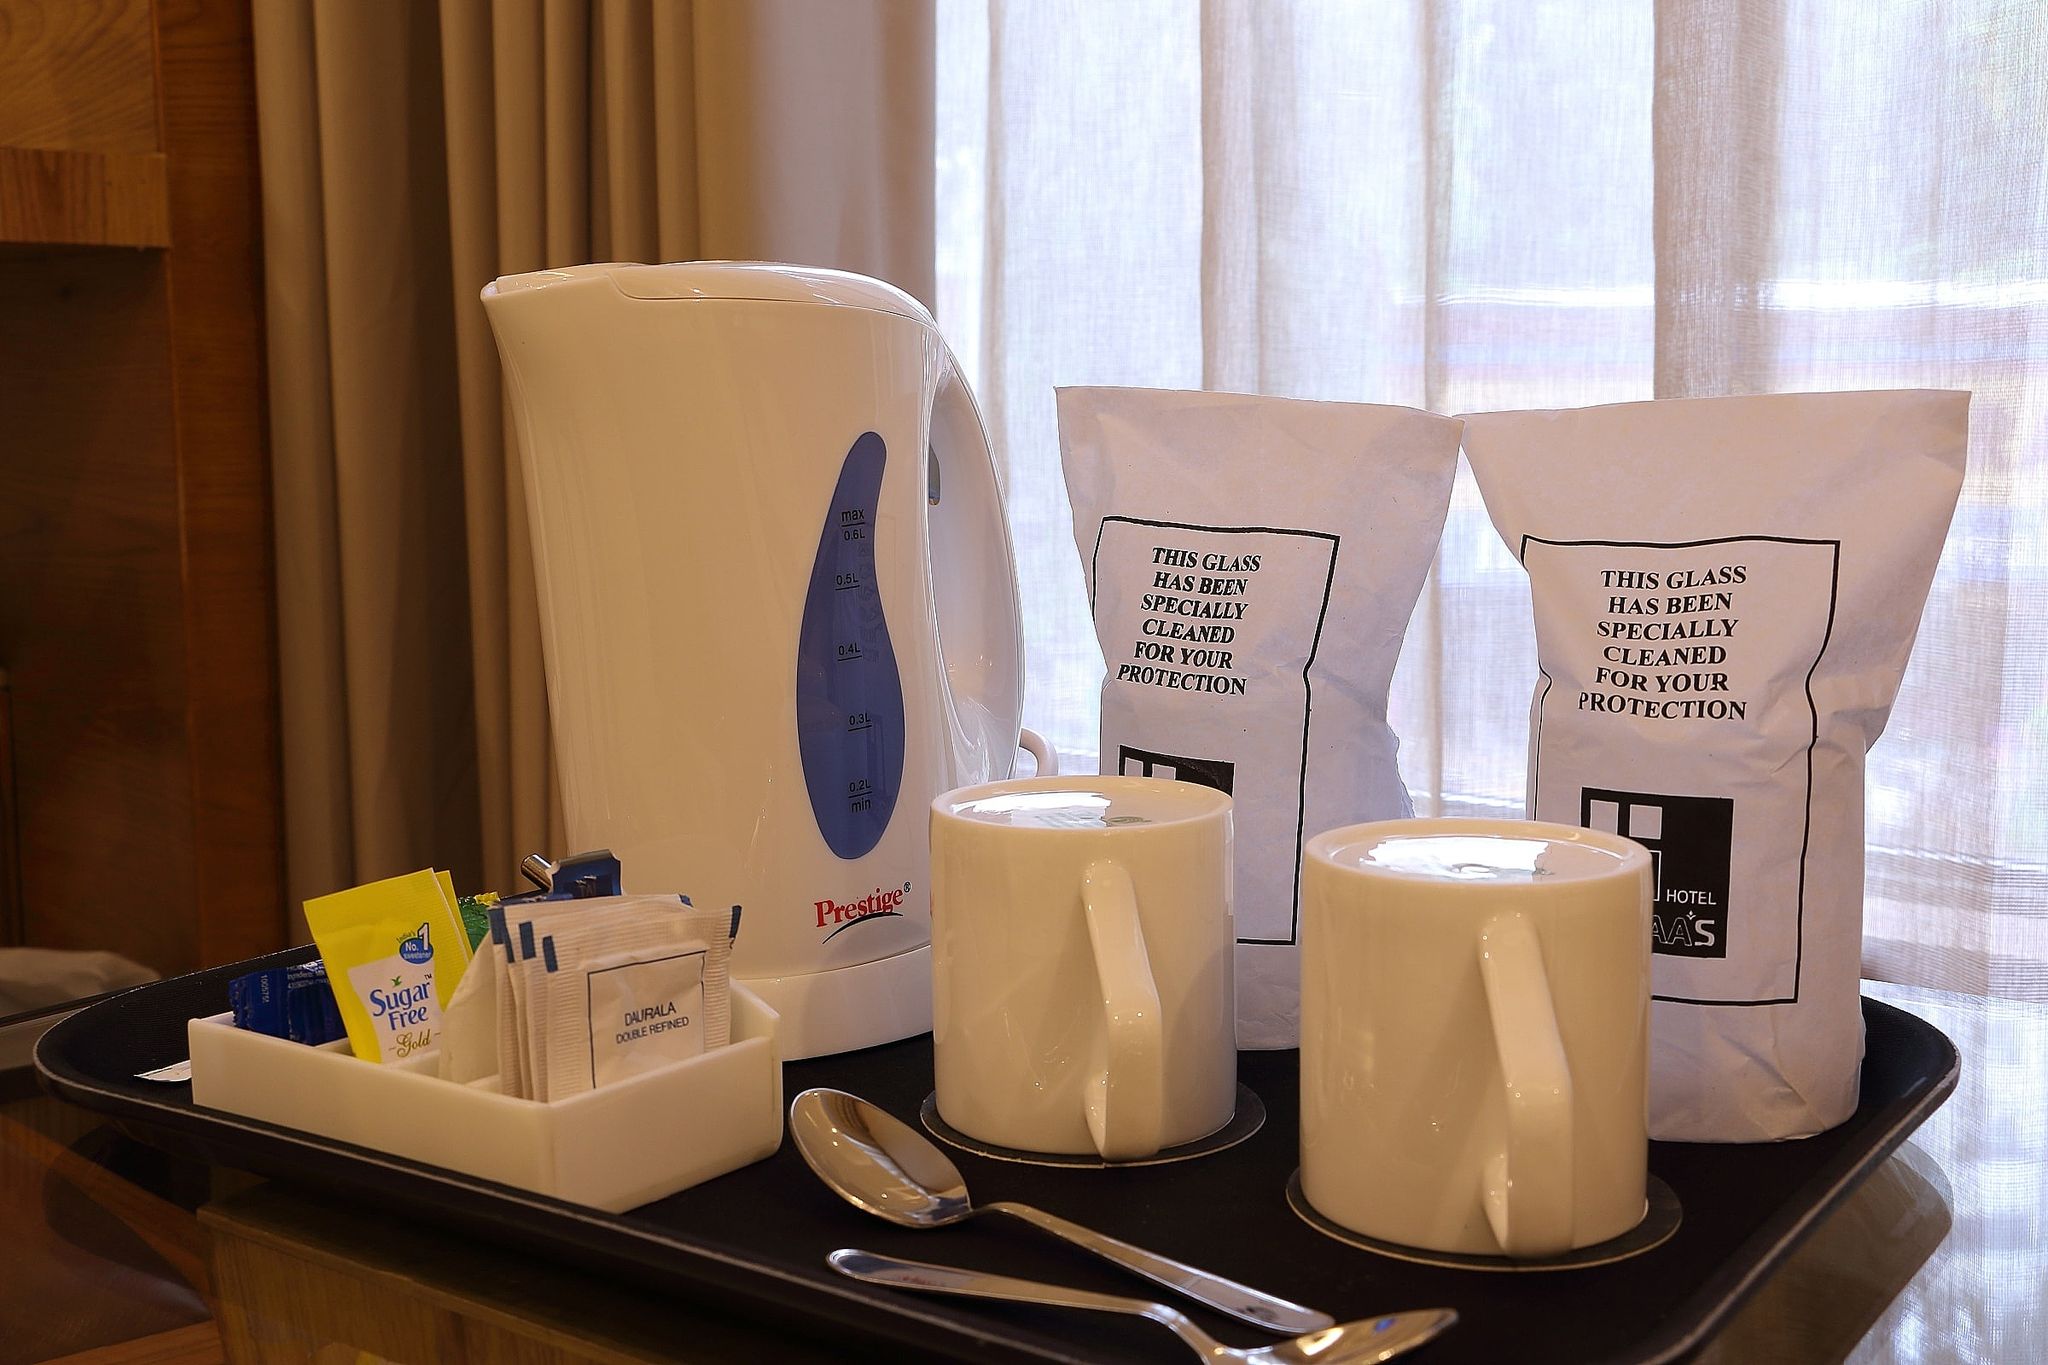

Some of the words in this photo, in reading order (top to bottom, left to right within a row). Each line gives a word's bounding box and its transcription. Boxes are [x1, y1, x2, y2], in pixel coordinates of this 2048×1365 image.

[841, 508, 864, 522] max
[843, 529, 866, 541] 0.6L
[1152, 547, 1198, 568] THIS
[1202, 553, 1262, 572] GLASS
[836, 573, 859, 586] 0.5L
[1153, 571, 1194, 592] HAS
[1197, 576, 1249, 596] BEEN
[1601, 569, 1659, 590] THIS
[1666, 565, 1747, 588] GLASS
[1140, 594, 1249, 620] SPECIALLY
[1608, 596, 1659, 616] HAS
[1665, 592, 1733, 615] BEEN
[1142, 618, 1236, 644] CLEANED
[1596, 618, 1739, 640] SPECIALLY
[838, 643, 861, 656] 0.4L
[1133, 641, 1174, 662] FOR
[1179, 647, 1234, 669] YOUR
[1603, 645, 1727, 667] CLEANED
[1116, 664, 1247, 696] PROTECTION
[1595, 667, 1648, 692] FOR
[1655, 672, 1729, 693] YOUR
[849, 712, 872, 726] 0.3L
[1579, 692, 1747, 721] PROTECTION
[849, 779, 872, 793] 0.2L
[851, 798, 871, 813] min
[1666, 889, 1717, 905] HOTEL
[417, 923, 429, 950] 1
[370, 982, 431, 1017] Sugar
[388, 1006, 429, 1030] Free
[624, 1001, 677, 1026] DAURALA
[616, 1026, 648, 1044] DOUBLE
[649, 1016, 689, 1035] REFINED
[396, 1029, 432, 1057] Gold
